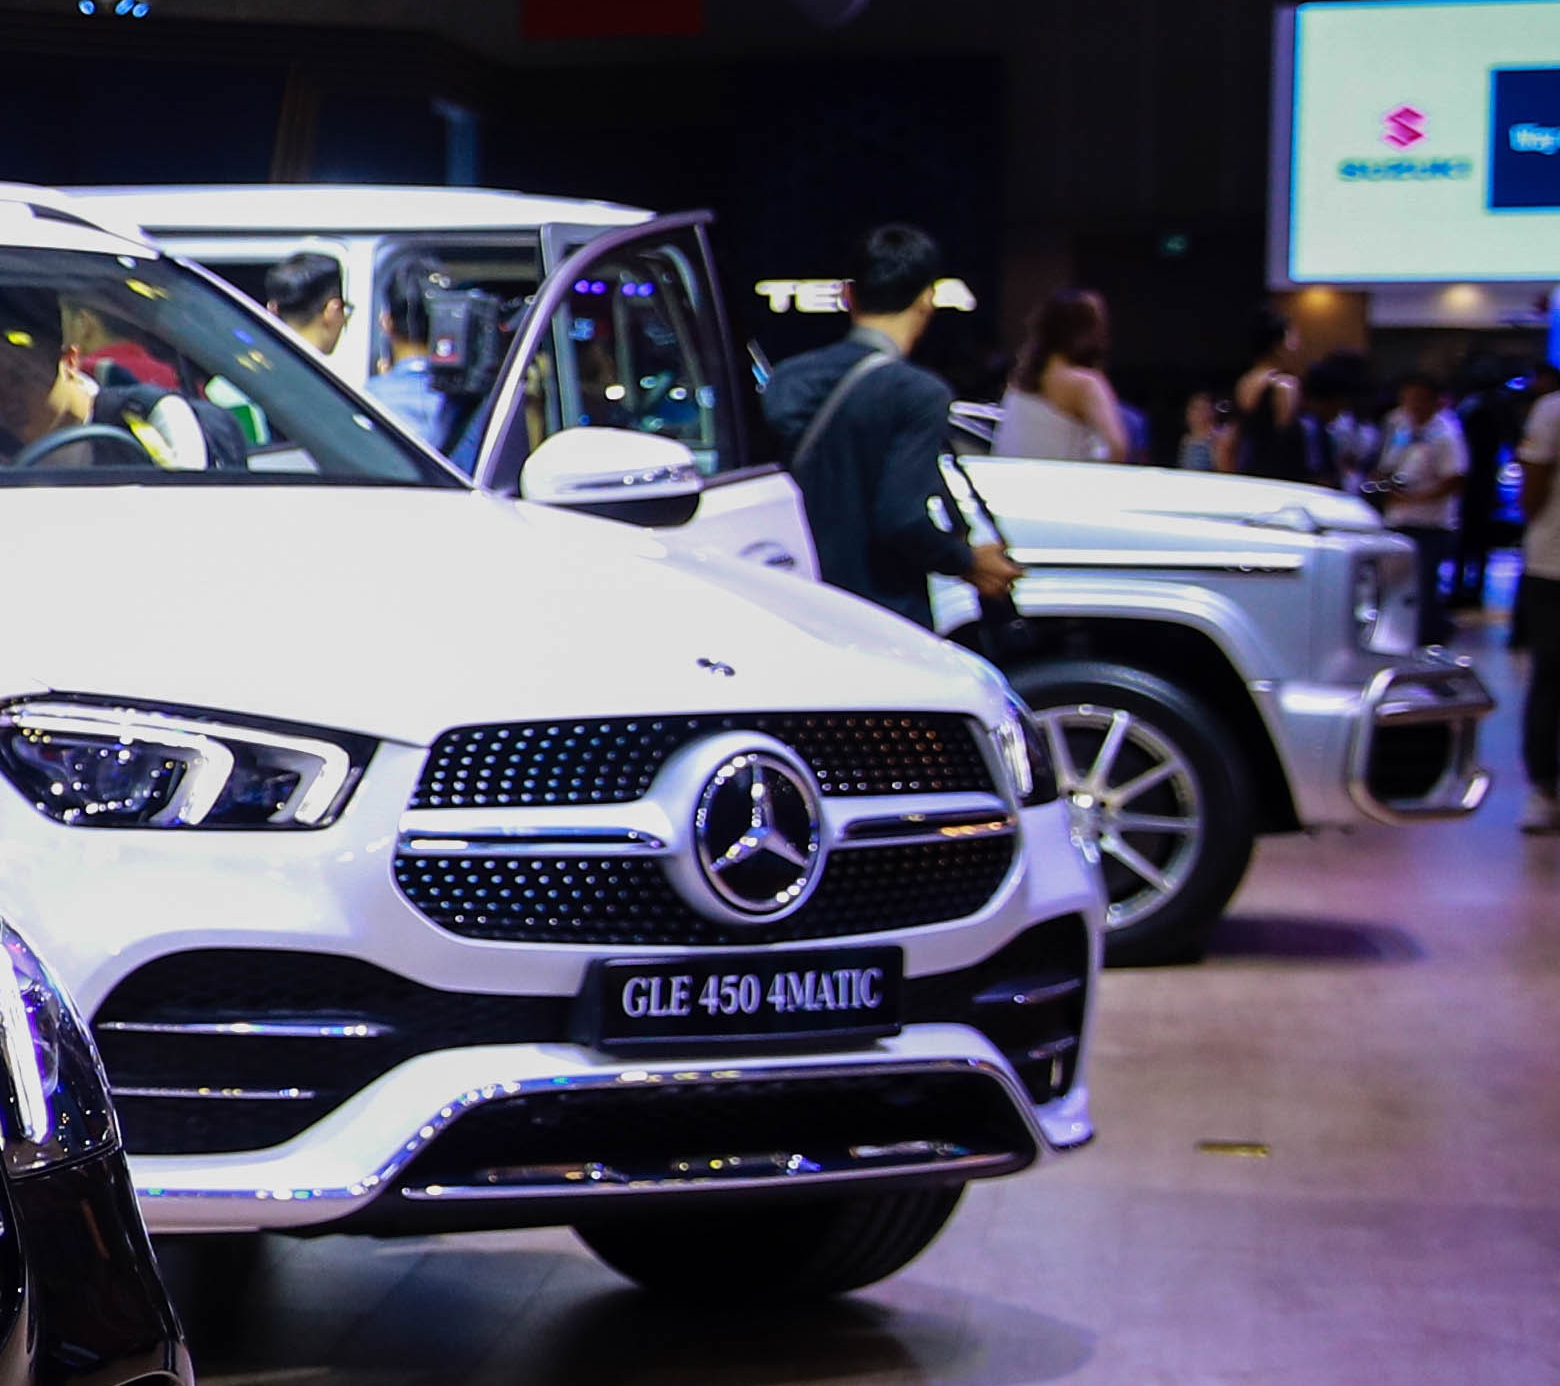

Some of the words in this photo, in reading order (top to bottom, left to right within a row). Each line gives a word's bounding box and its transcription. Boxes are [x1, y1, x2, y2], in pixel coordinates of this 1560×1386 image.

[622, 975, 691, 1018] GLE
[699, 974, 760, 1015] 450
[766, 967, 883, 1012] 4MATIC
